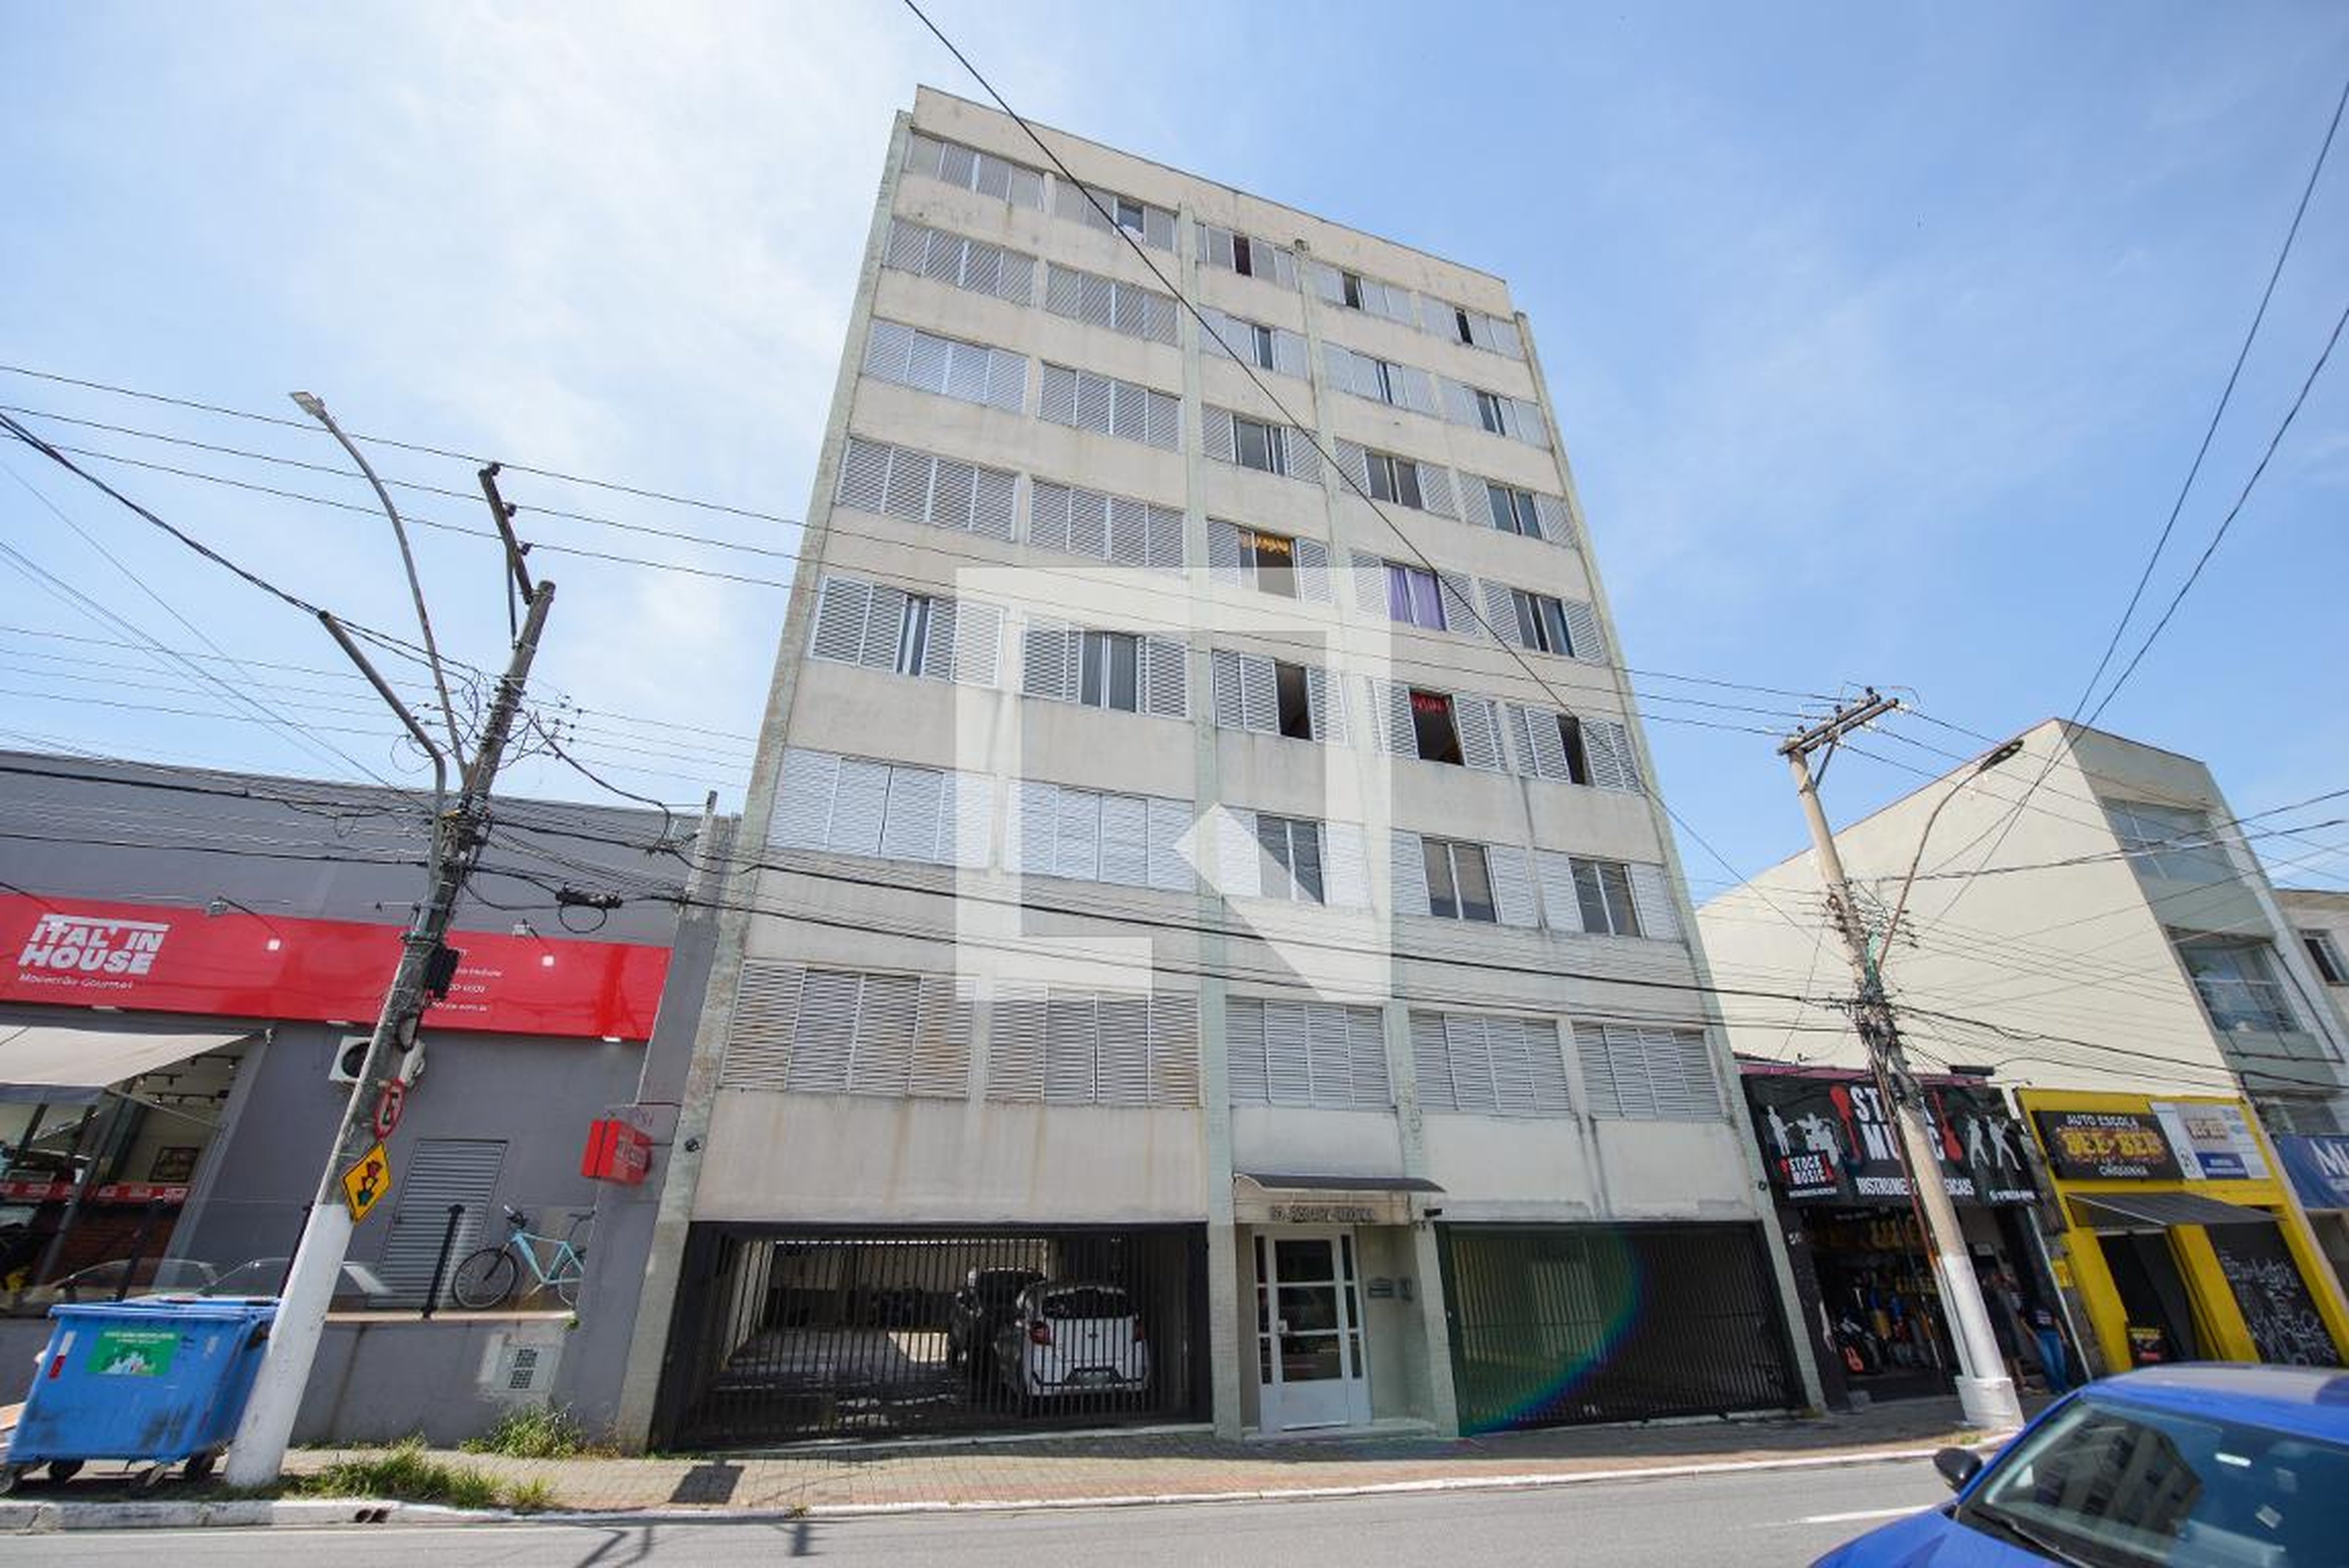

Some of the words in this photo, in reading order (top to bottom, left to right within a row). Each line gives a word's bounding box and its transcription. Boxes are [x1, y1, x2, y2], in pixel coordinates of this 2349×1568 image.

[17, 942, 157, 975] HOUSE
[2066, 1114, 2096, 1126] AUTO
[2097, 1115, 2140, 1128] ESCOLA
